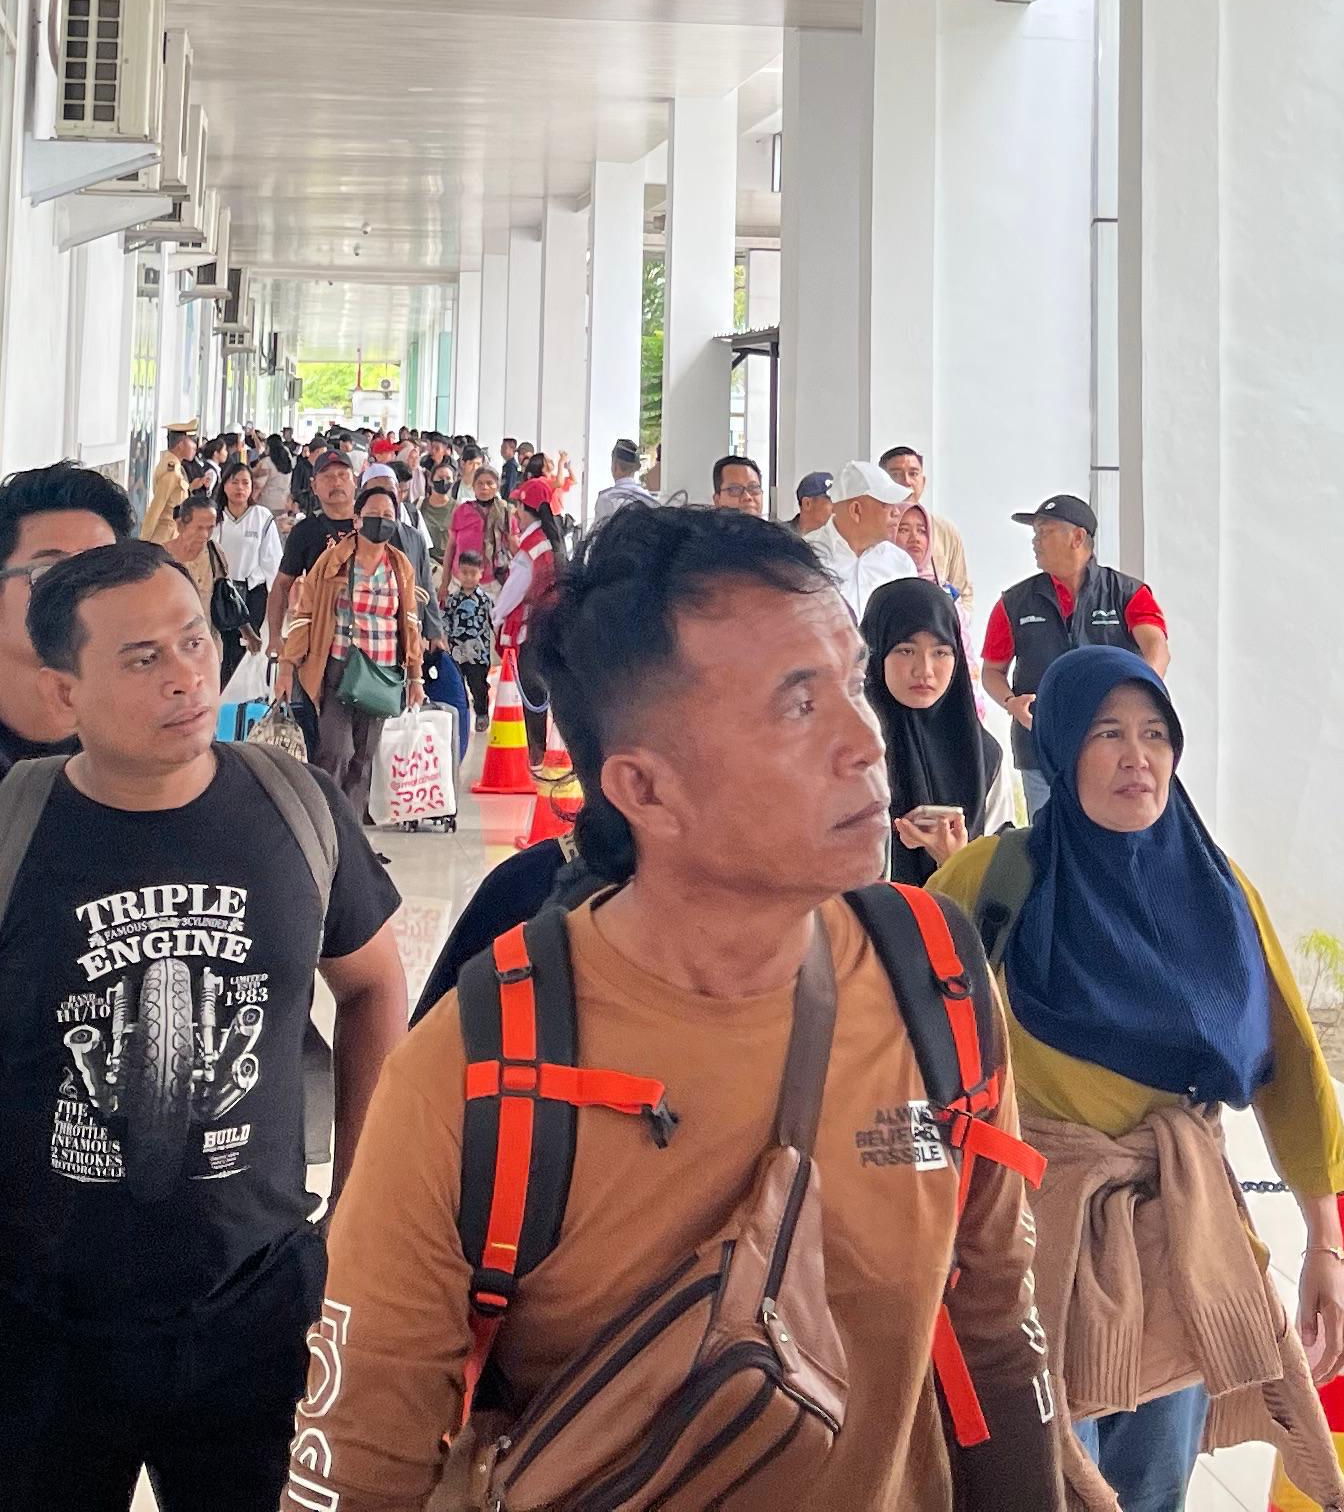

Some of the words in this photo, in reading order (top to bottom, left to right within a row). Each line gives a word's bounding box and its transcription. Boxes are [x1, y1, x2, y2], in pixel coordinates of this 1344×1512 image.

[75, 884, 248, 934] TRIPLE
[104, 921, 148, 942] FAMOUS
[76, 929, 253, 982] ENGINE
[225, 987, 268, 1006] 1983
[57, 1099, 88, 1117] THE
[55, 1120, 108, 1140] THROTTLE
[203, 1124, 250, 1149] BUILD
[51, 1133, 120, 1154] INFAMOUS
[61, 1148, 123, 1167] STROKES
